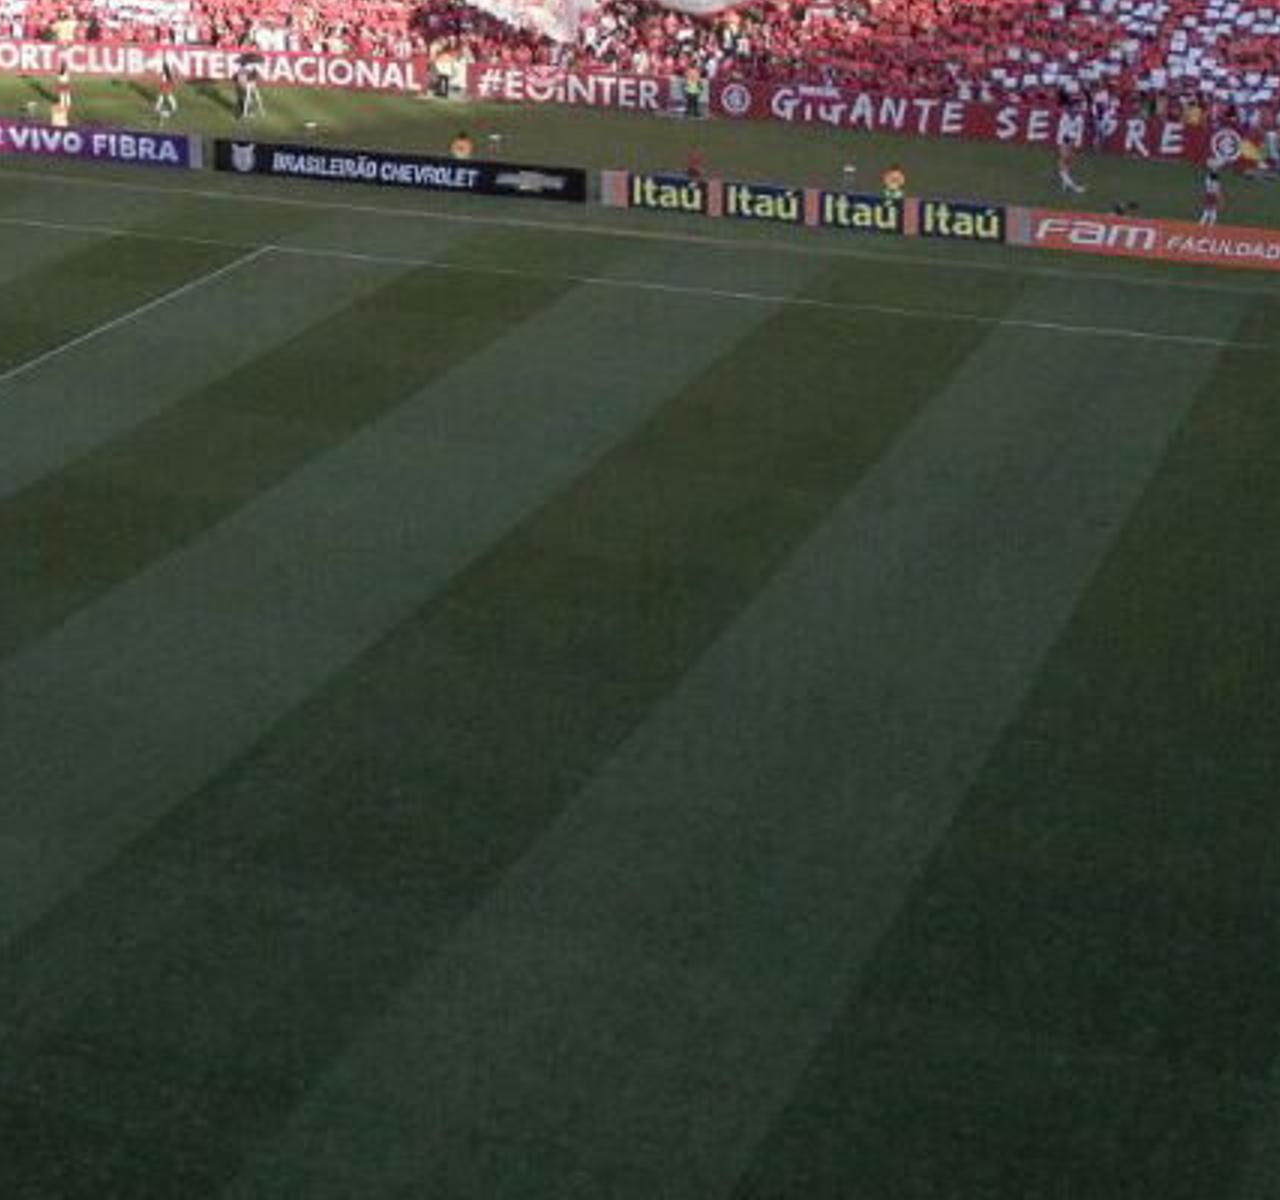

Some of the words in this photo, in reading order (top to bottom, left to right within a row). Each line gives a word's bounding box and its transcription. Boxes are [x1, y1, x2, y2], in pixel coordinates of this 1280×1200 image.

[70, 46, 144, 75] CLUB
[156, 50, 422, 92] INTERNACIONAL
[8, 125, 83, 154] VIVO
[91, 133, 180, 163] FIBRA
[271, 150, 378, 179] BRASILEIRÃO
[380, 161, 478, 189] CHEVROLET
[631, 175, 702, 209] Itaú
[727, 184, 799, 220] Itaú
[823, 193, 897, 230] Itaú
[923, 201, 999, 239] Itaú
